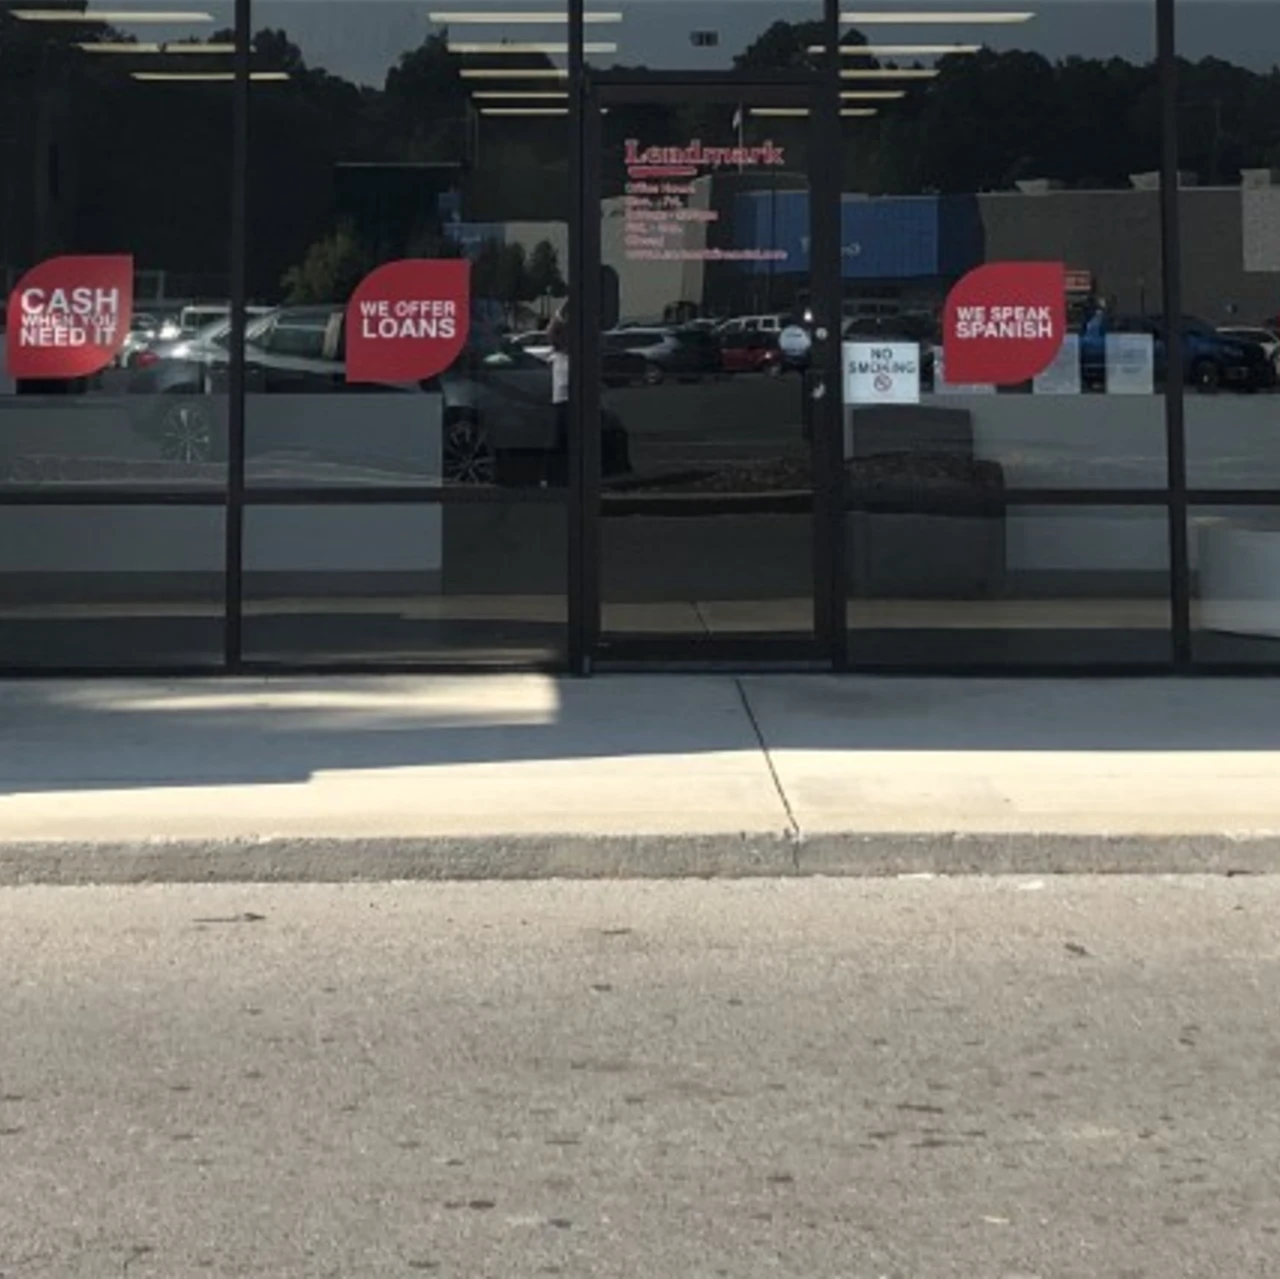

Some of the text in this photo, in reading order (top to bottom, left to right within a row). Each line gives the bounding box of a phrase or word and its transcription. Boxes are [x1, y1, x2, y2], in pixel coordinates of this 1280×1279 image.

[21, 287, 119, 314] CASH
[360, 300, 455, 317] WE OFFER
[21, 313, 74, 327] WHEN
[956, 306, 1051, 321] WE SPEAK
[362, 317, 456, 338] LOANS
[956, 321, 1053, 338] SPANISH
[20, 326, 116, 347] NEED IT
[870, 348, 893, 360] NO
